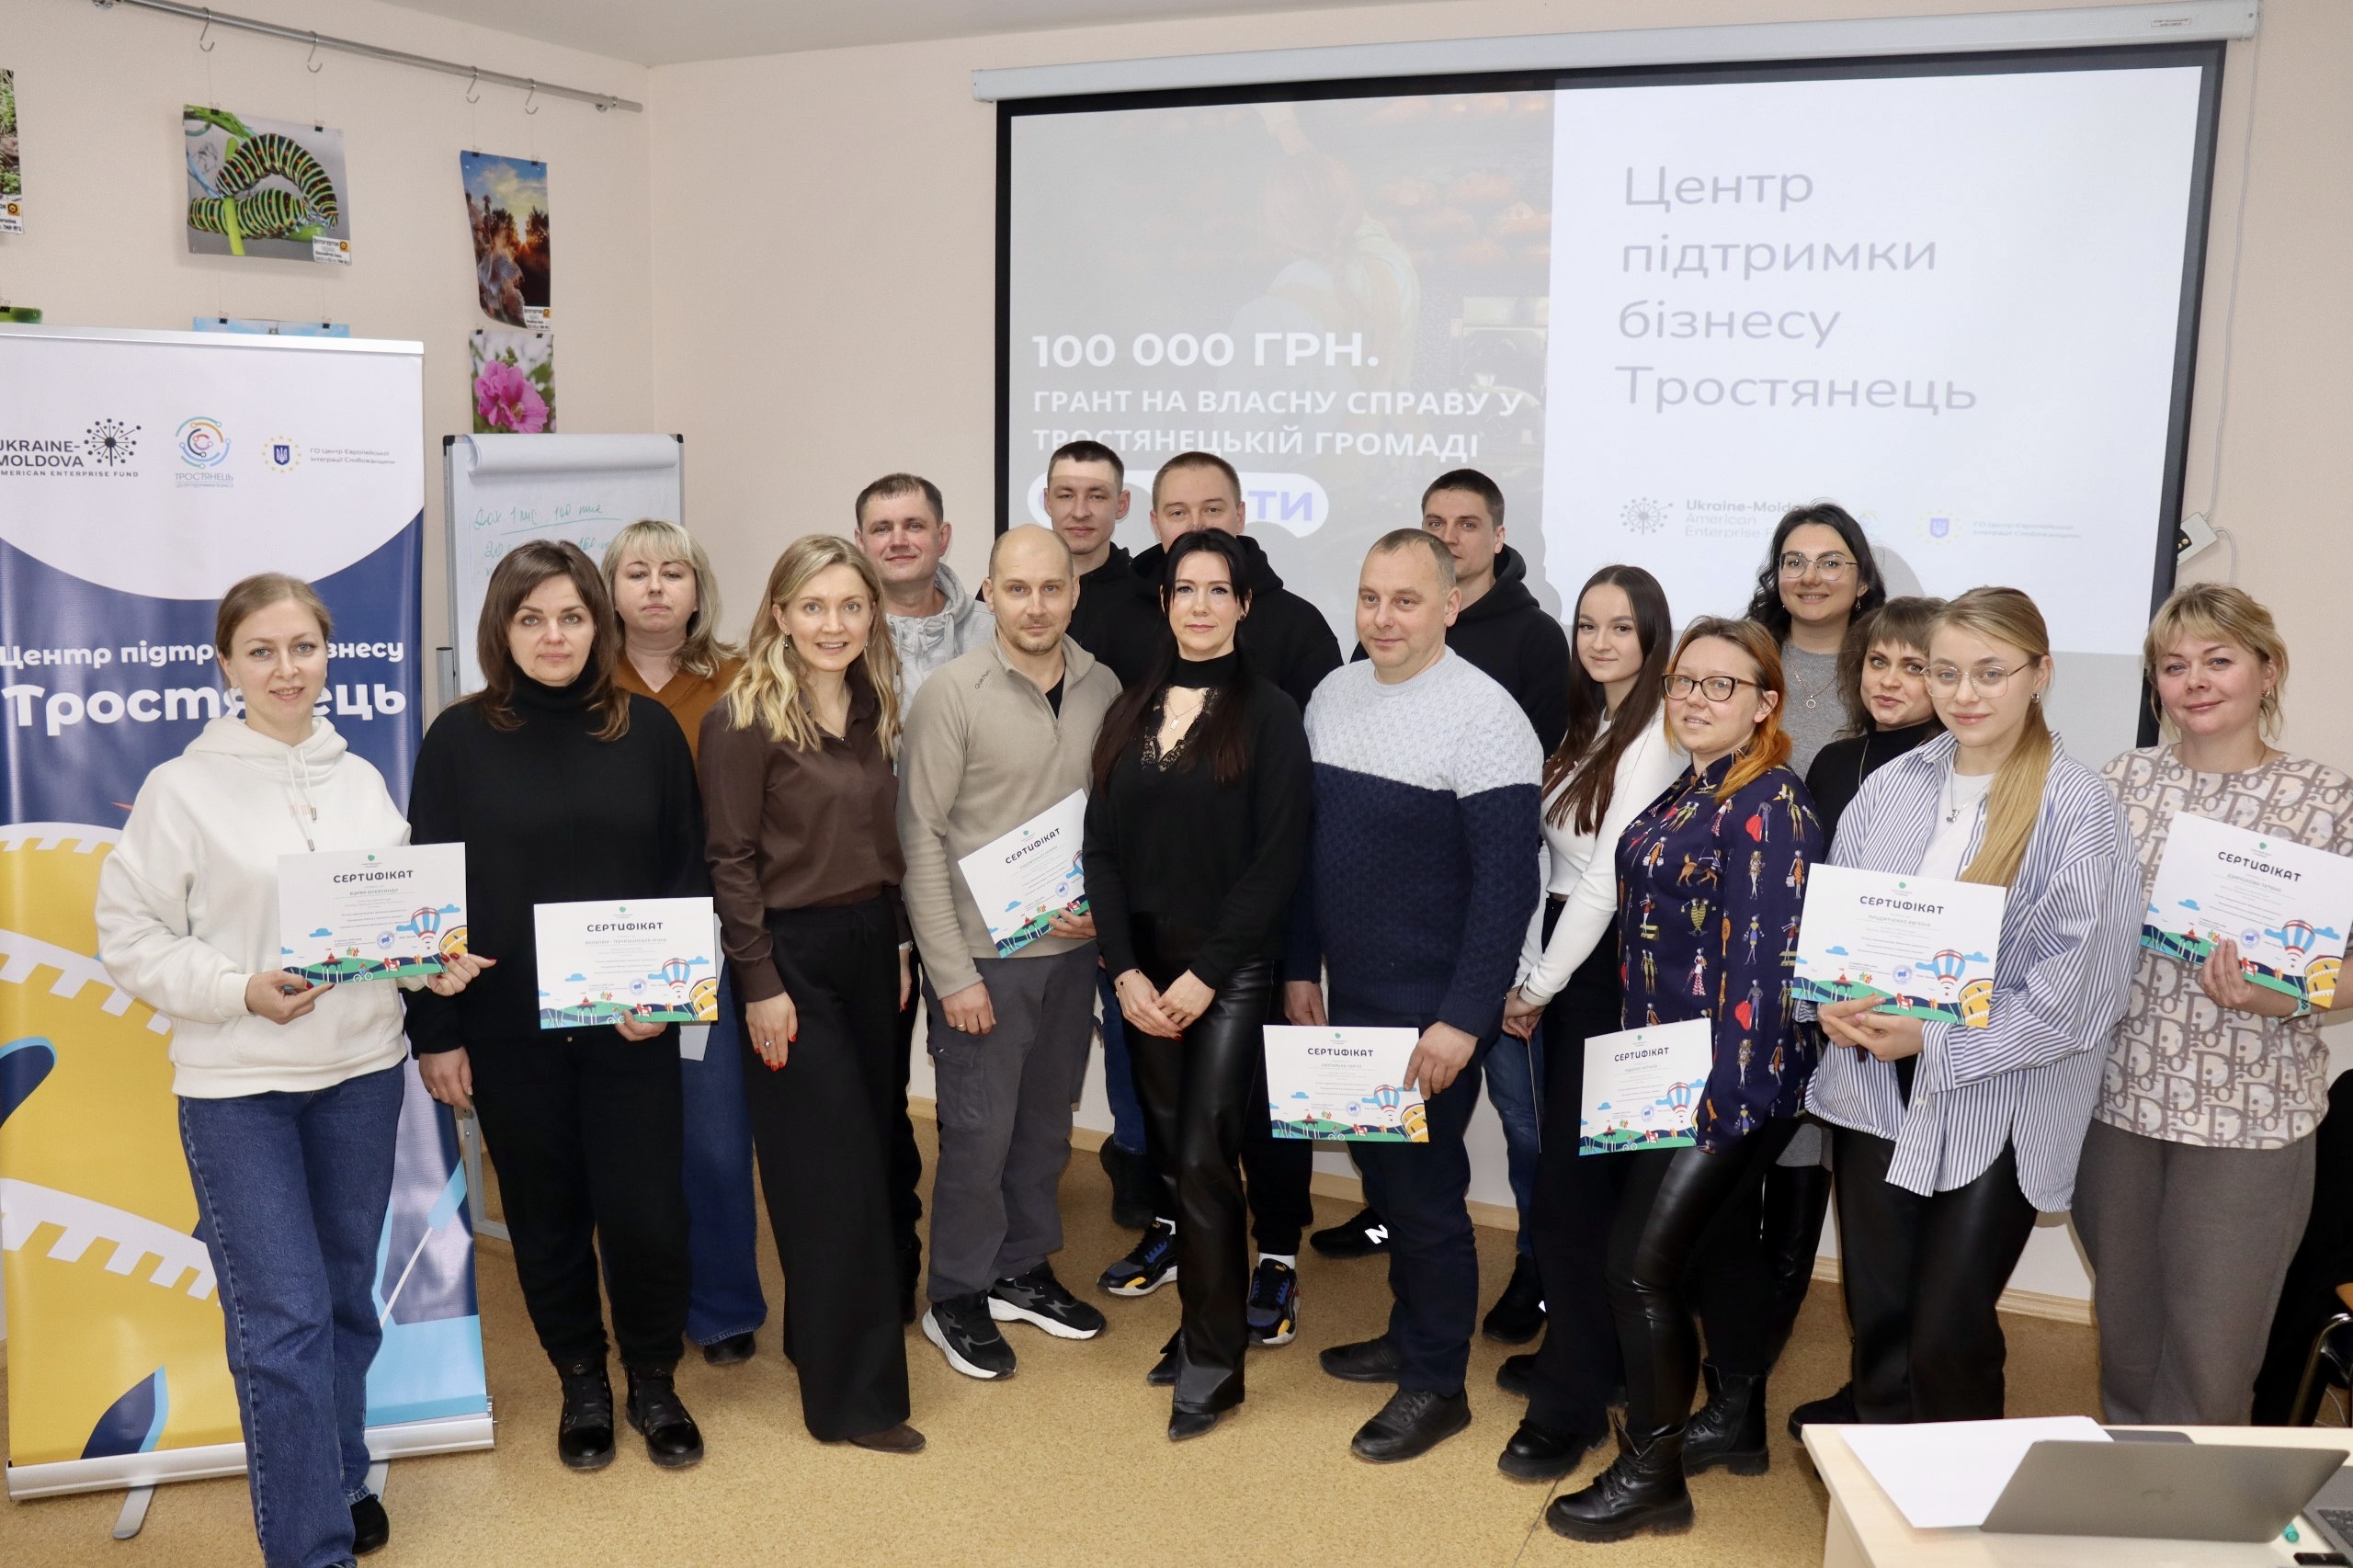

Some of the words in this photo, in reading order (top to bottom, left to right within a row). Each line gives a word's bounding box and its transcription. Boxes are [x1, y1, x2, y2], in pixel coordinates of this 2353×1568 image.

[1625, 165, 1814, 213] Центр
[1622, 233, 1937, 280] підтримки
[1619, 299, 1841, 349] бізнесу
[1031, 333, 1116, 368] 100
[1131, 332, 1235, 367] 000
[1253, 332, 1380, 367] ГРН.
[1033, 390, 1132, 413] ГРАНТ
[1142, 390, 1188, 413] НА
[1197, 390, 1337, 414] ВЛАСНУ
[1347, 391, 1490, 415] СПРАВУ
[1498, 392, 1525, 417] У
[1614, 365, 1977, 416] Тростянець
[1315, 432, 1478, 464] ГРОМАДІ
[1686, 499, 1792, 513] Ukraine-Mold
[1686, 513, 1756, 526] American
[1686, 525, 1760, 539] Enterprise
[0, 645, 112, 669] Центр
[120, 640, 215, 667] підтр
[327, 642, 404, 663] знесу
[1005, 827, 1060, 864] СЕРТИФІКАТ
[333, 869, 414, 883] СЕРТИФІКАТ
[2218, 851, 2302, 882] СЕРТИФІКАТ
[1859, 895, 1945, 915] СЕРТИФІКАТ
[586, 922, 664, 932] СЕРТИФІКАТ
[1307, 1047, 1374, 1057] СЕРТИФІКАТ
[1614, 1047, 1669, 1062] СЕРТИФІКАТ
